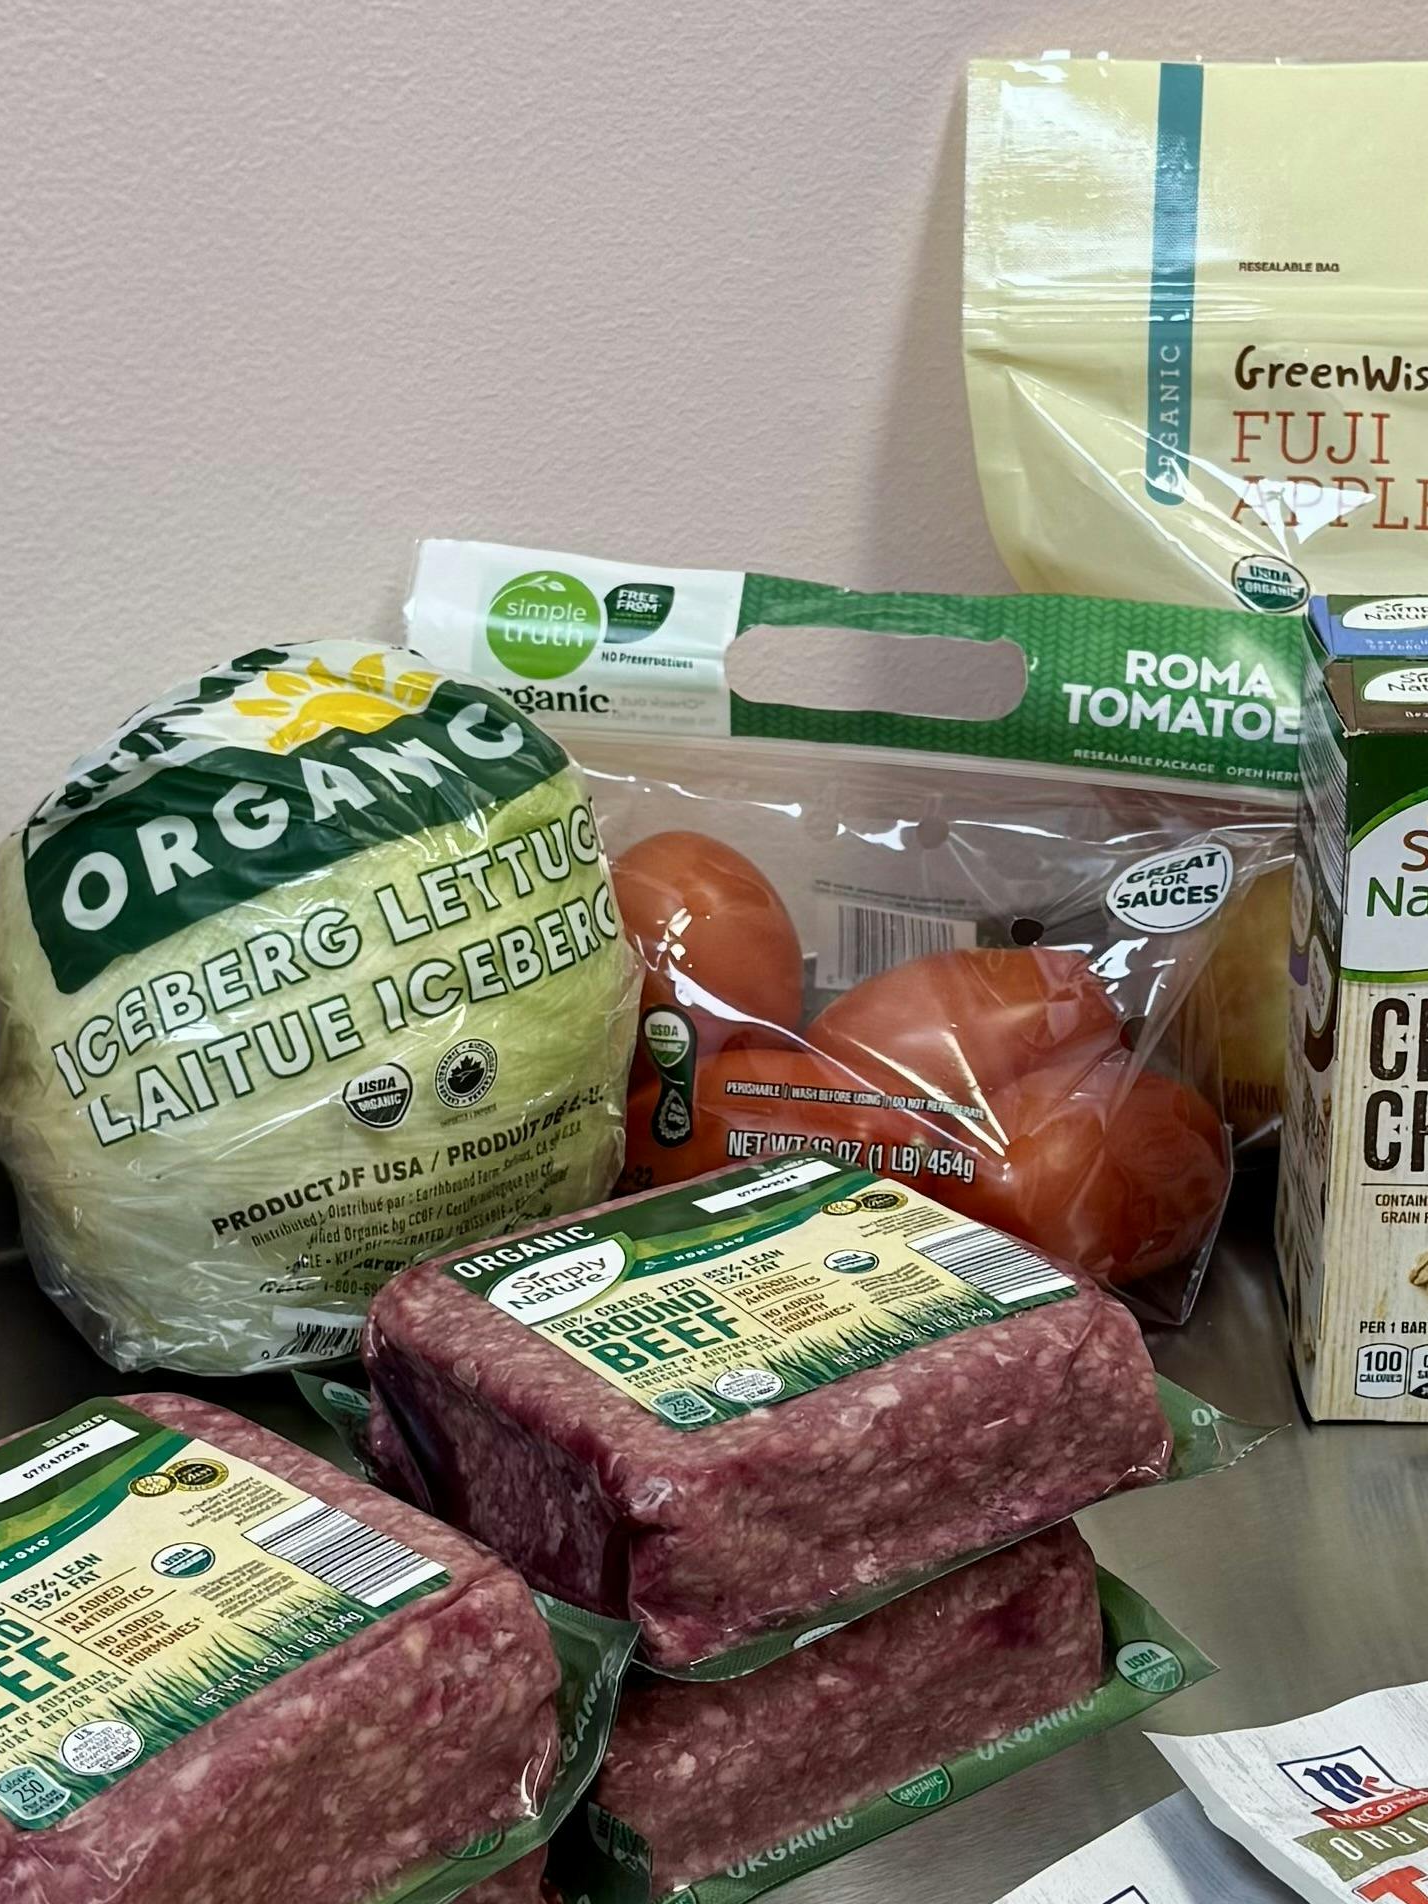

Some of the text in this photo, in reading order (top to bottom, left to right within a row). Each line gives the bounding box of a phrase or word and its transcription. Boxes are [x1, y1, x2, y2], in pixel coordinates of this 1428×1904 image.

[1232, 412, 1389, 464] FUJI
[505, 599, 586, 622] simple
[505, 622, 584, 648] truth
[1124, 650, 1276, 701] ROMA
[1063, 683, 1299, 744] TOMATOE
[1127, 846, 1221, 888] GREAT
[1149, 871, 1187, 888] FOR
[1117, 880, 1220, 910] SAUCES
[55, 809, 599, 1097] ICEBERG LETTUC
[88, 997, 362, 1146] LAITUE
[454, 1225, 596, 1279] ORGANIC
[562, 1288, 714, 1350] GROUND
[588, 1305, 741, 1375] BEEF
